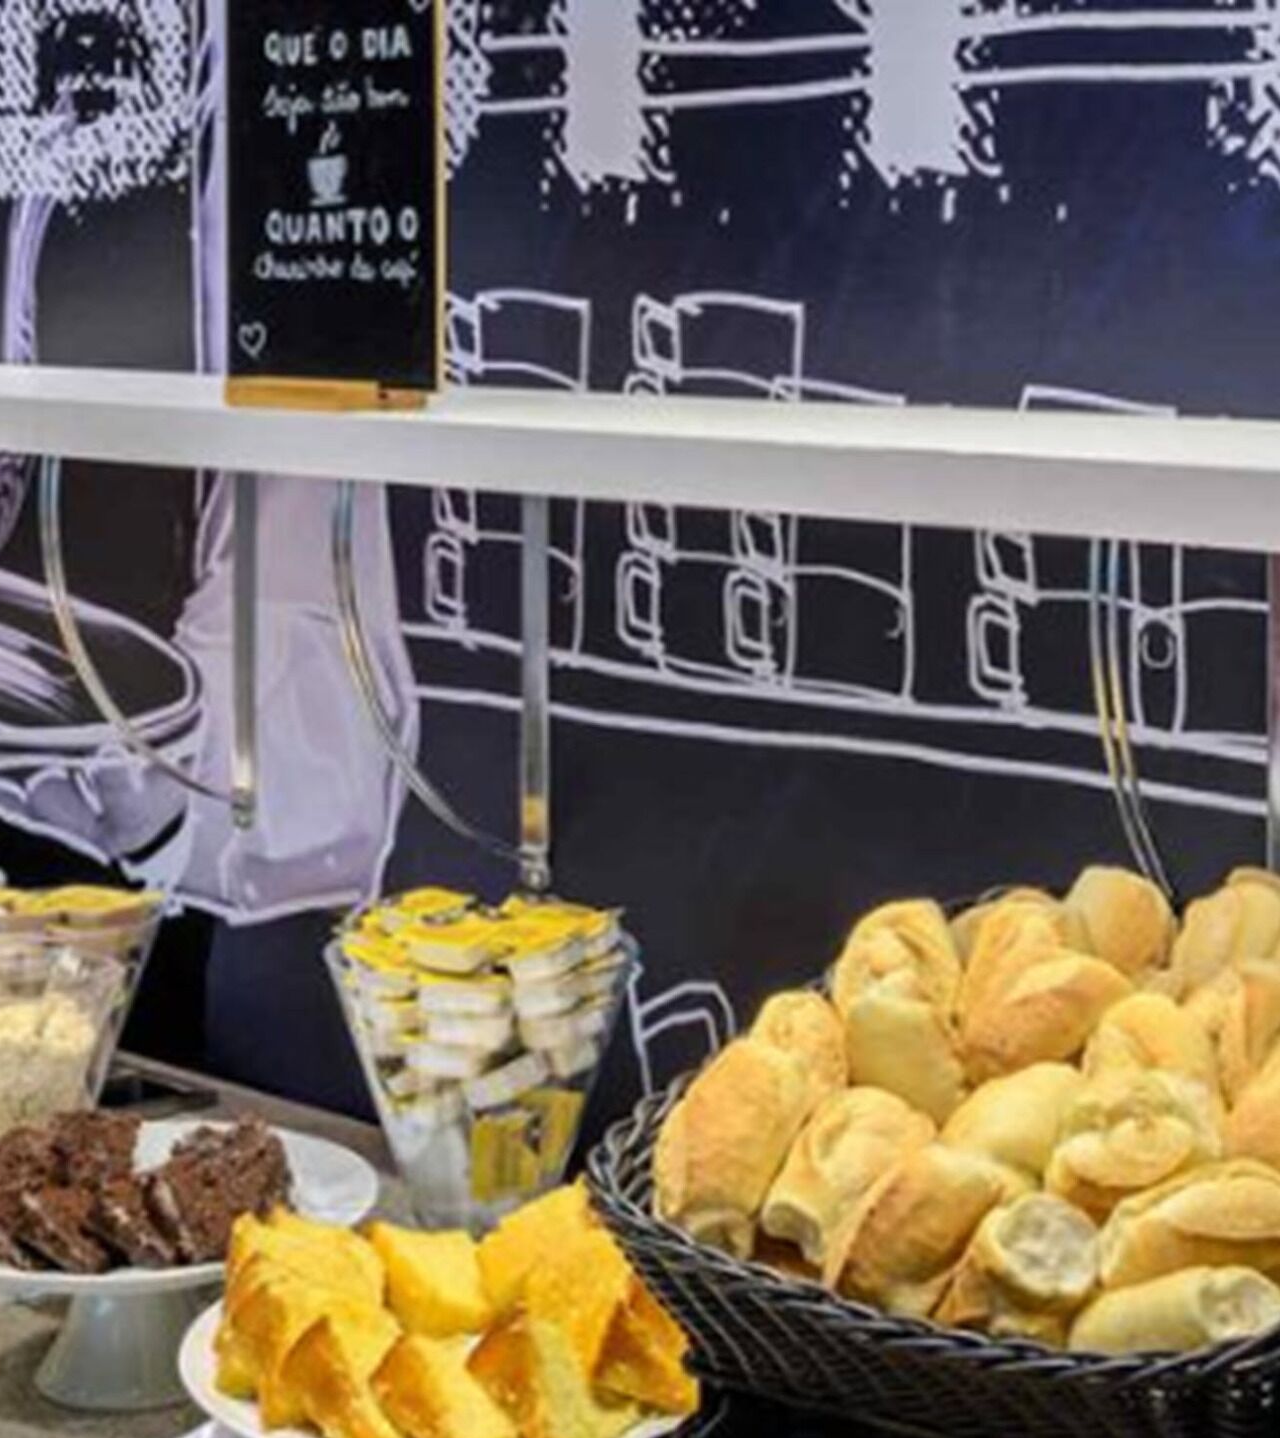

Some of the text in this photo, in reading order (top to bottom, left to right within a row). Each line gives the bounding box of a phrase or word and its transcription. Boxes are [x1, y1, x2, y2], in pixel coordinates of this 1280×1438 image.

[263, 24, 412, 66] QUE O DIA
[265, 205, 419, 245] QUANTO O
